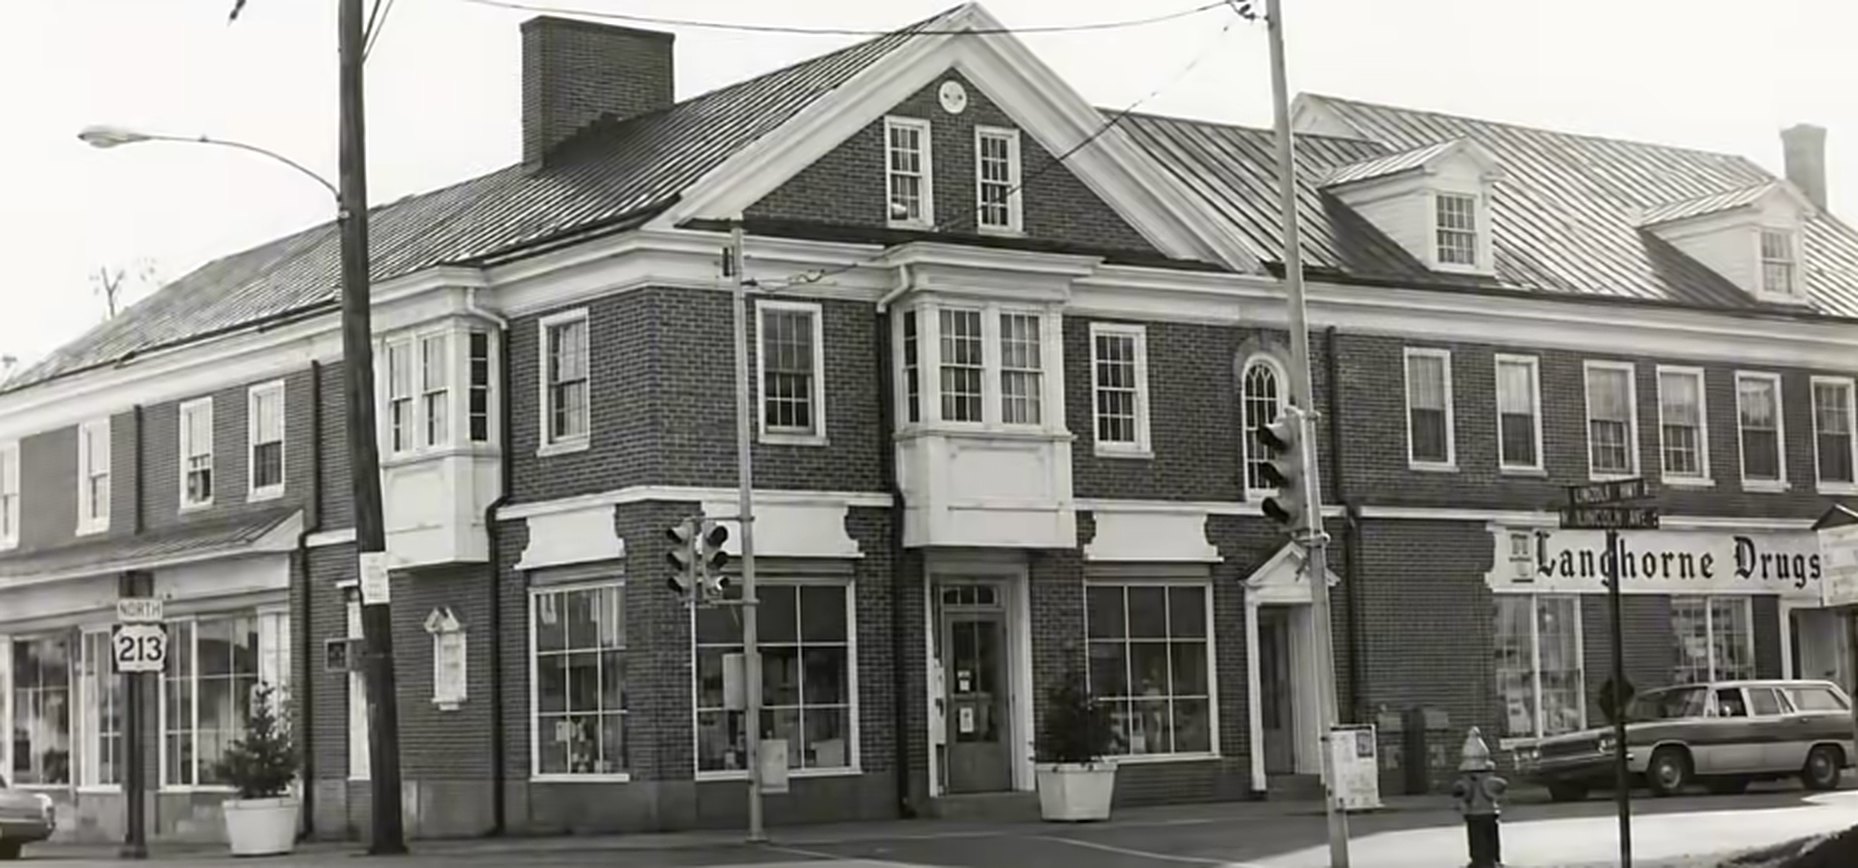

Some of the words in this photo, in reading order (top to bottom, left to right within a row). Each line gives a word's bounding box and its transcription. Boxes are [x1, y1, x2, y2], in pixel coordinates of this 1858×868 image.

[1576, 509, 1622, 527] LINCOLN
[1535, 531, 1714, 587] Langhorne
[1733, 535, 1821, 589] Drugs
[120, 602, 160, 616] NORTH
[120, 636, 162, 661] 213
